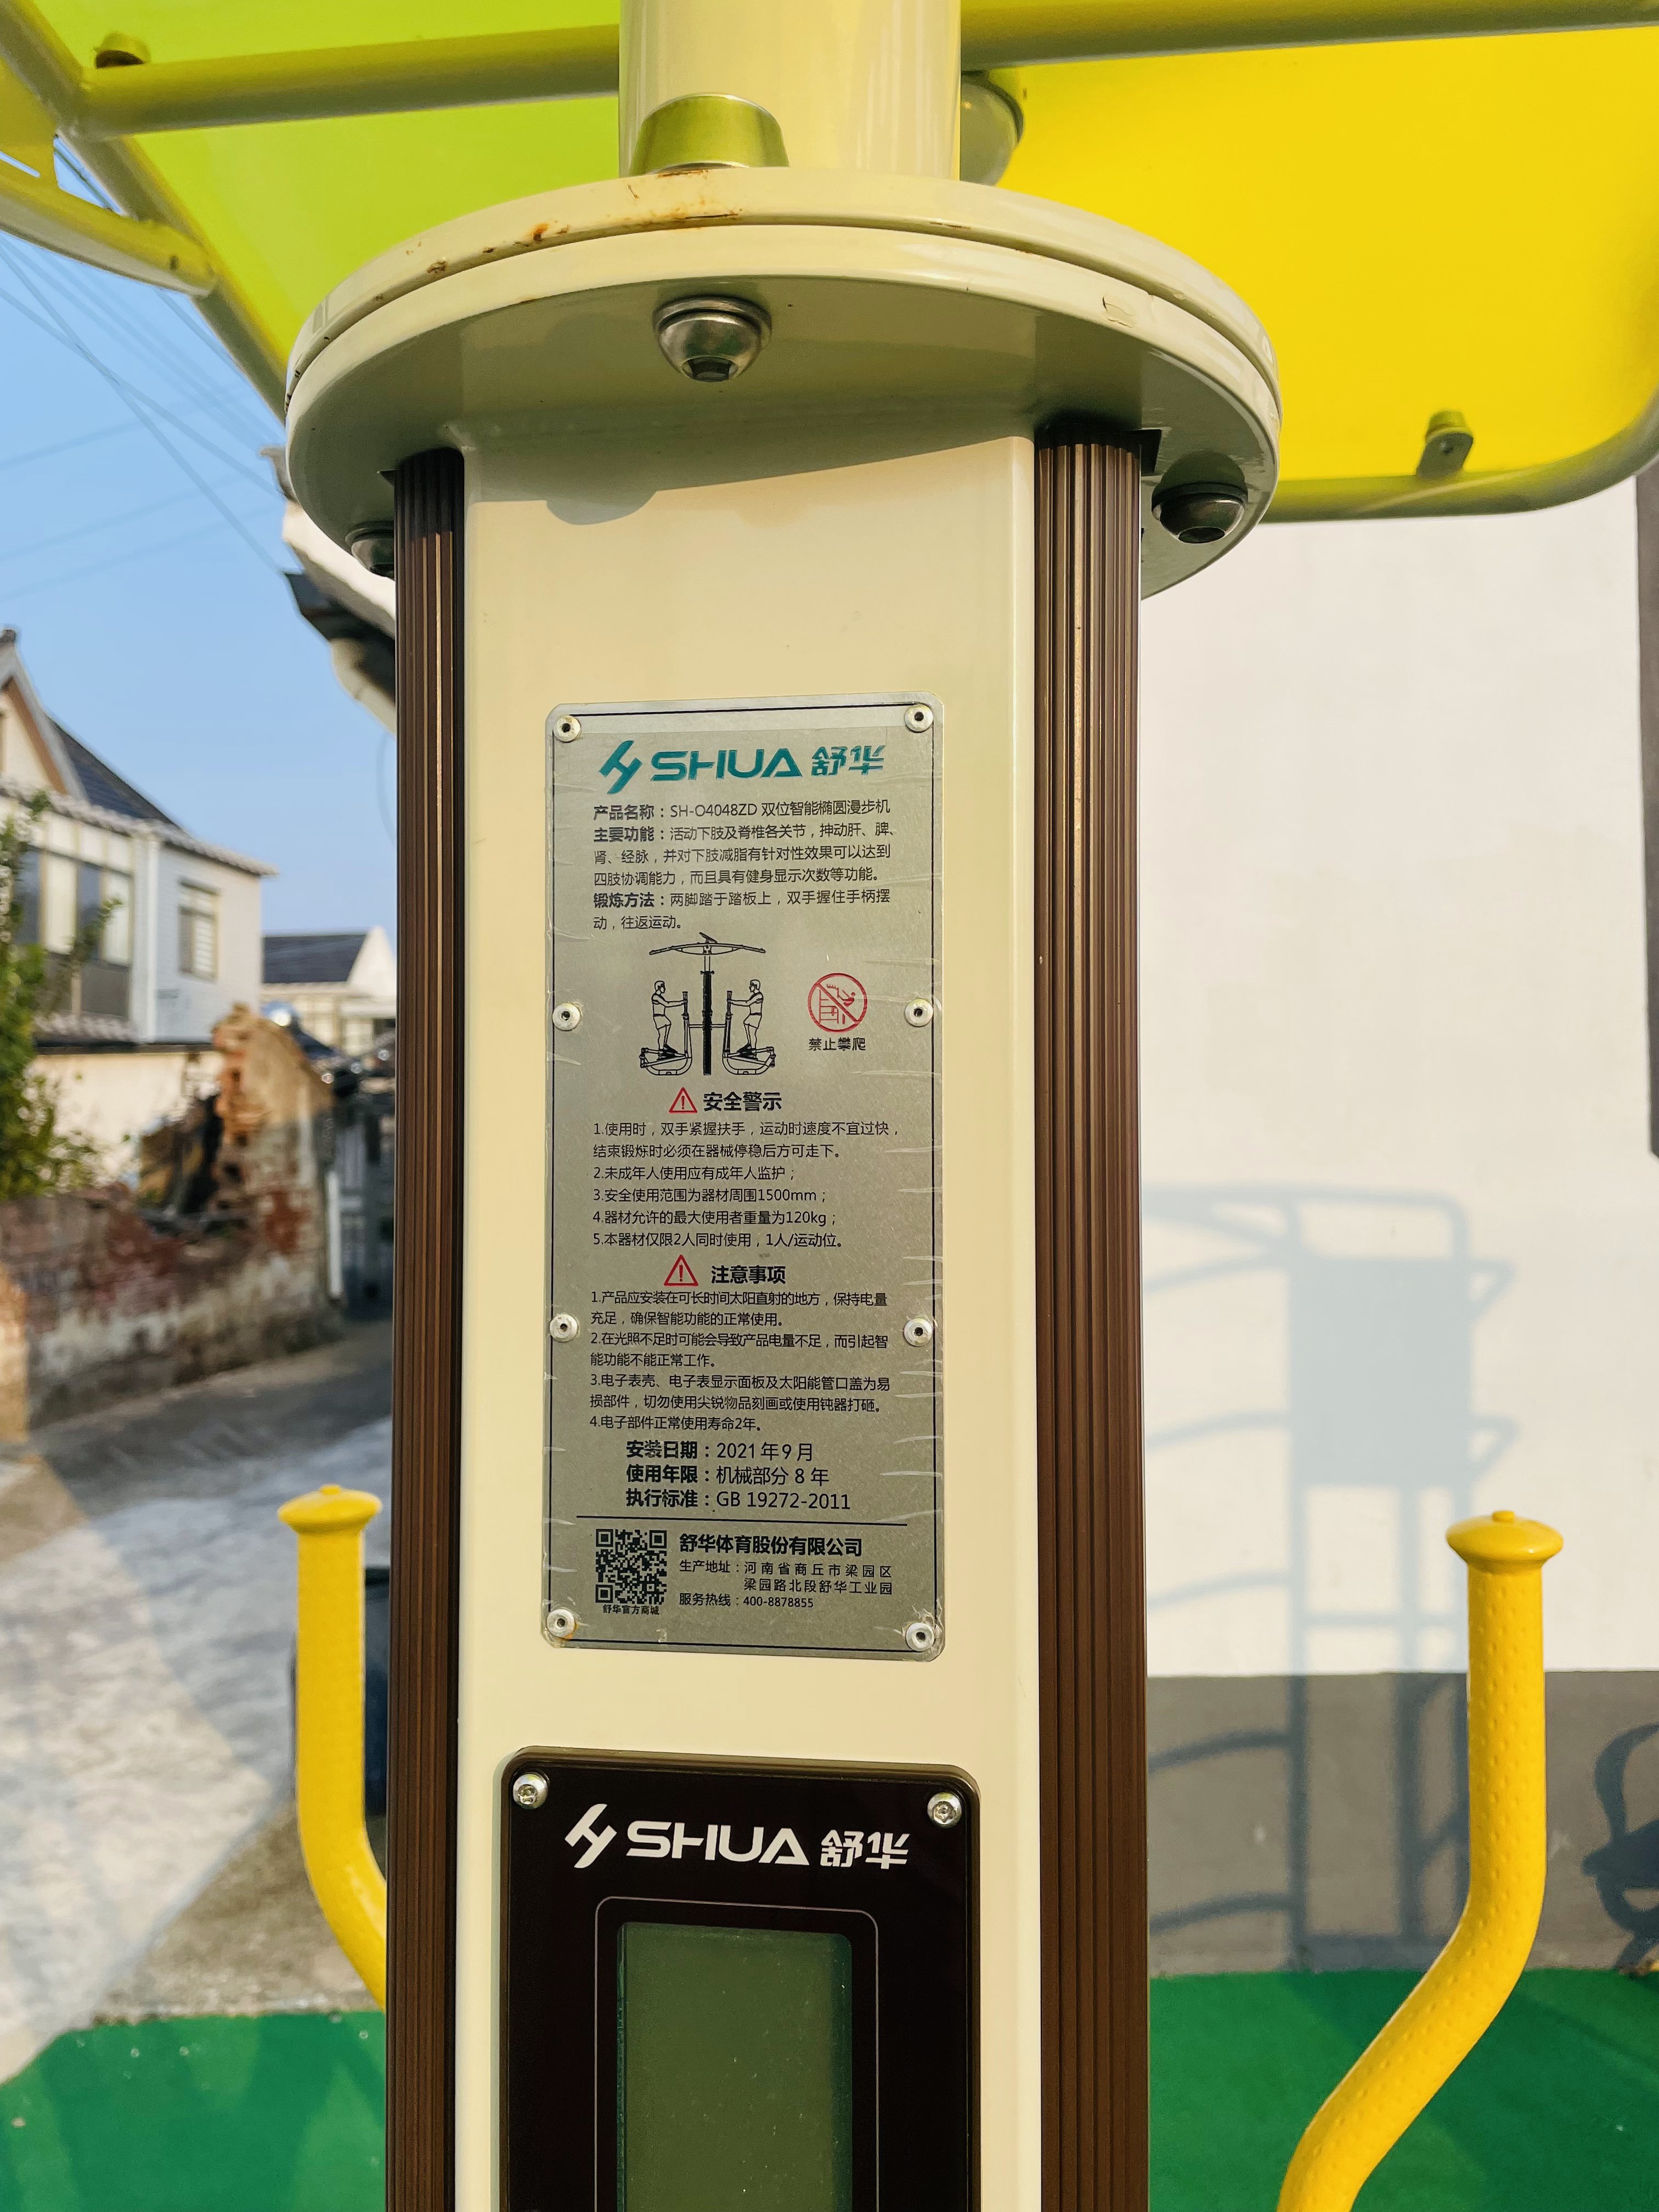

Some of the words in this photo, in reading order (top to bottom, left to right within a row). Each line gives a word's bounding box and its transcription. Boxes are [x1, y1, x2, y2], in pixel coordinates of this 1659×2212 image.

[651, 748, 802, 781] SHUA
[811, 745, 886, 776] 舒华
[594, 843, 890, 865] 肾、经脉，并对下肢减脂有针对性效果可以达到
[594, 866, 877, 887] 四肢协调能力，而且具有健身显示次数等功能。
[593, 915, 681, 930] 动，往返运动。
[808, 1036, 866, 1052] 禁止攀爬
[703, 1091, 782, 1112] 安全警示
[594, 1121, 898, 1137] 1.使用时，双手紧握扶手，运动时速度不宜过快，
[593, 1143, 839, 1159] 结束锻炼时必须在器械停稳后方可走下。
[593, 1165, 794, 1181] 2.未成年人使用应有成年人监护；
[593, 1188, 825, 1203] 3.安全使用范围为器材周围1500mm；
[592, 1210, 836, 1227] 4.器材允许的最大使用者重量为120kg；
[593, 1232, 842, 1248] 5.本器材仅限2人同时使用，1人/运动位。
[710, 1265, 786, 1285] 注意事项
[591, 1290, 888, 1307] 1.产品应安装在可长时间太阳直射的地方，保持电量
[590, 1311, 782, 1327] 充足，确保智能功能的正常使用。
[590, 1331, 888, 1349] 2.在光照不足时可能会导致产品电量不足，而引起智
[590, 1352, 715, 1368] 能功能不能正常工作。
[590, 1373, 890, 1391] 3.电子表壳、电子表显示面板及太阳能管口盖为易
[589, 1393, 879, 1413] 损部件，切勿使用尖锐物品刻画或使用钝器打砸。
[589, 1414, 761, 1432] 4.电子部件正常使用寿命2年。
[747, 1492, 850, 1510] 19272-2011
[679, 1533, 862, 1557] 舒华体育股份有限公司
[602, 1604, 660, 1616] 舒华官方商城
[626, 1820, 810, 1866] SHUA
[820, 1829, 910, 1870] 舒华
